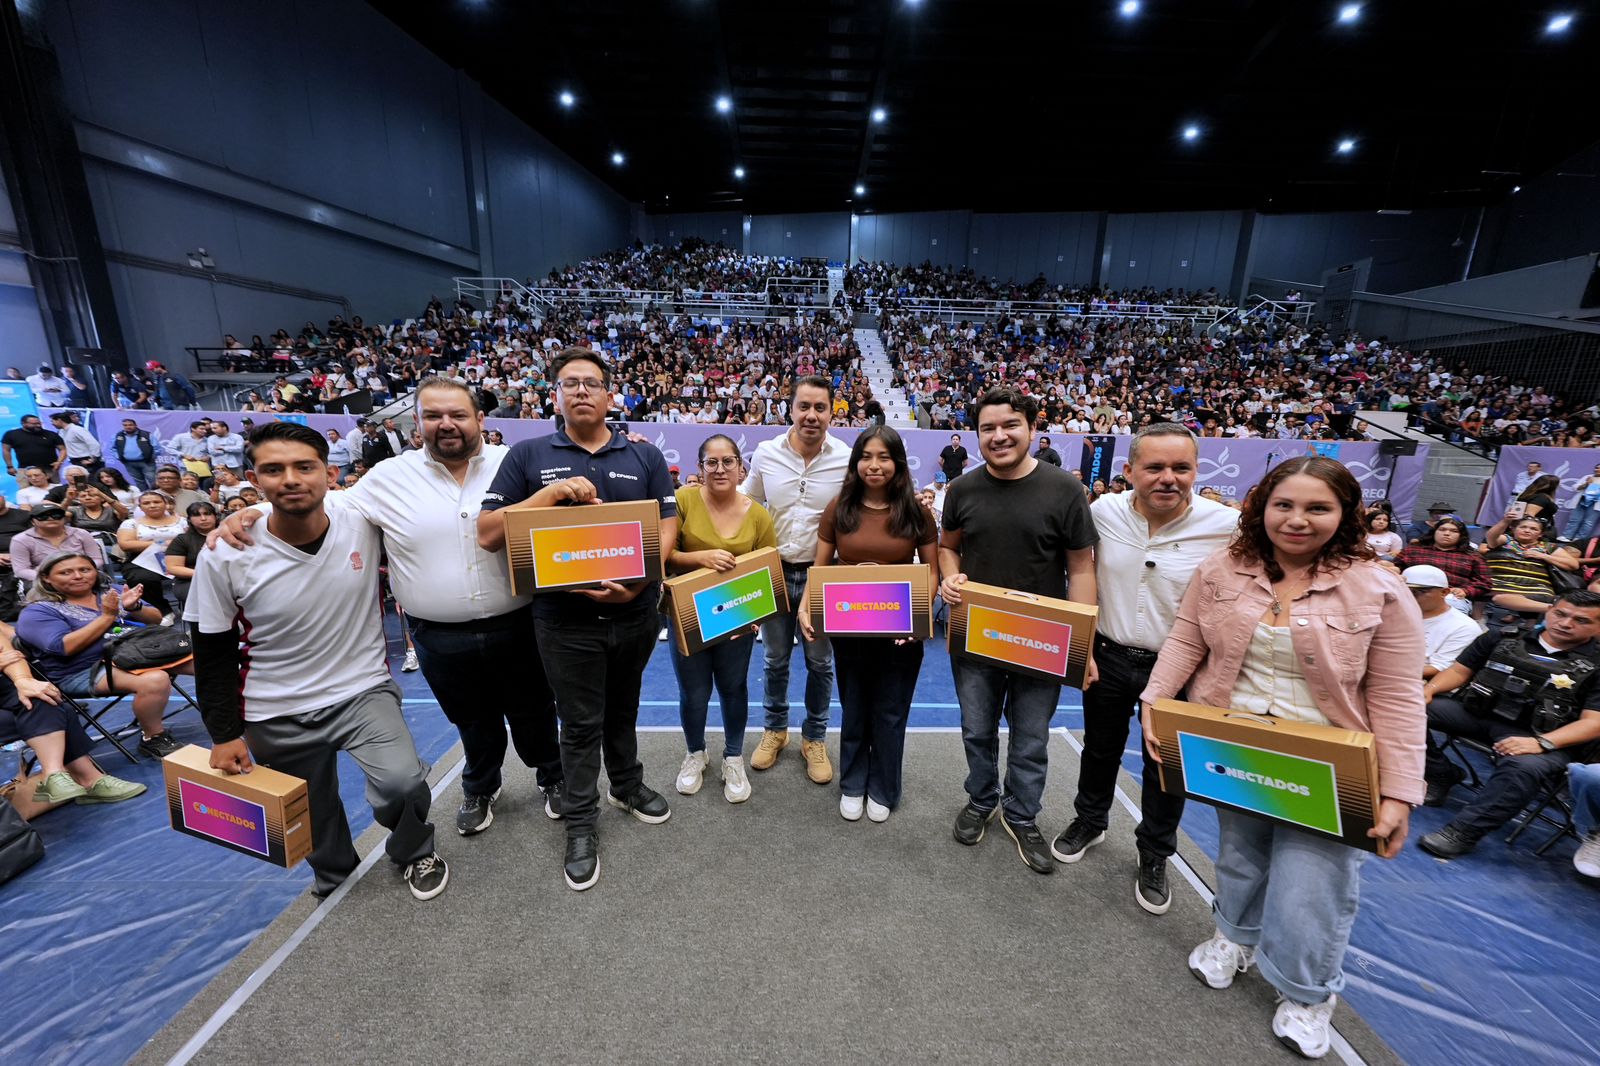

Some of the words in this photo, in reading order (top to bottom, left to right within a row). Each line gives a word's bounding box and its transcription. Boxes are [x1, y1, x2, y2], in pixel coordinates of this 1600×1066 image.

[553, 546, 635, 562] CONECTADOS
[712, 589, 763, 615] CONECTADOS
[835, 601, 900, 612] CONECTADOS
[983, 628, 1060, 654] CONECTADOS
[1205, 761, 1311, 796] CONECTADOS
[193, 801, 256, 831] CONECTADOS
